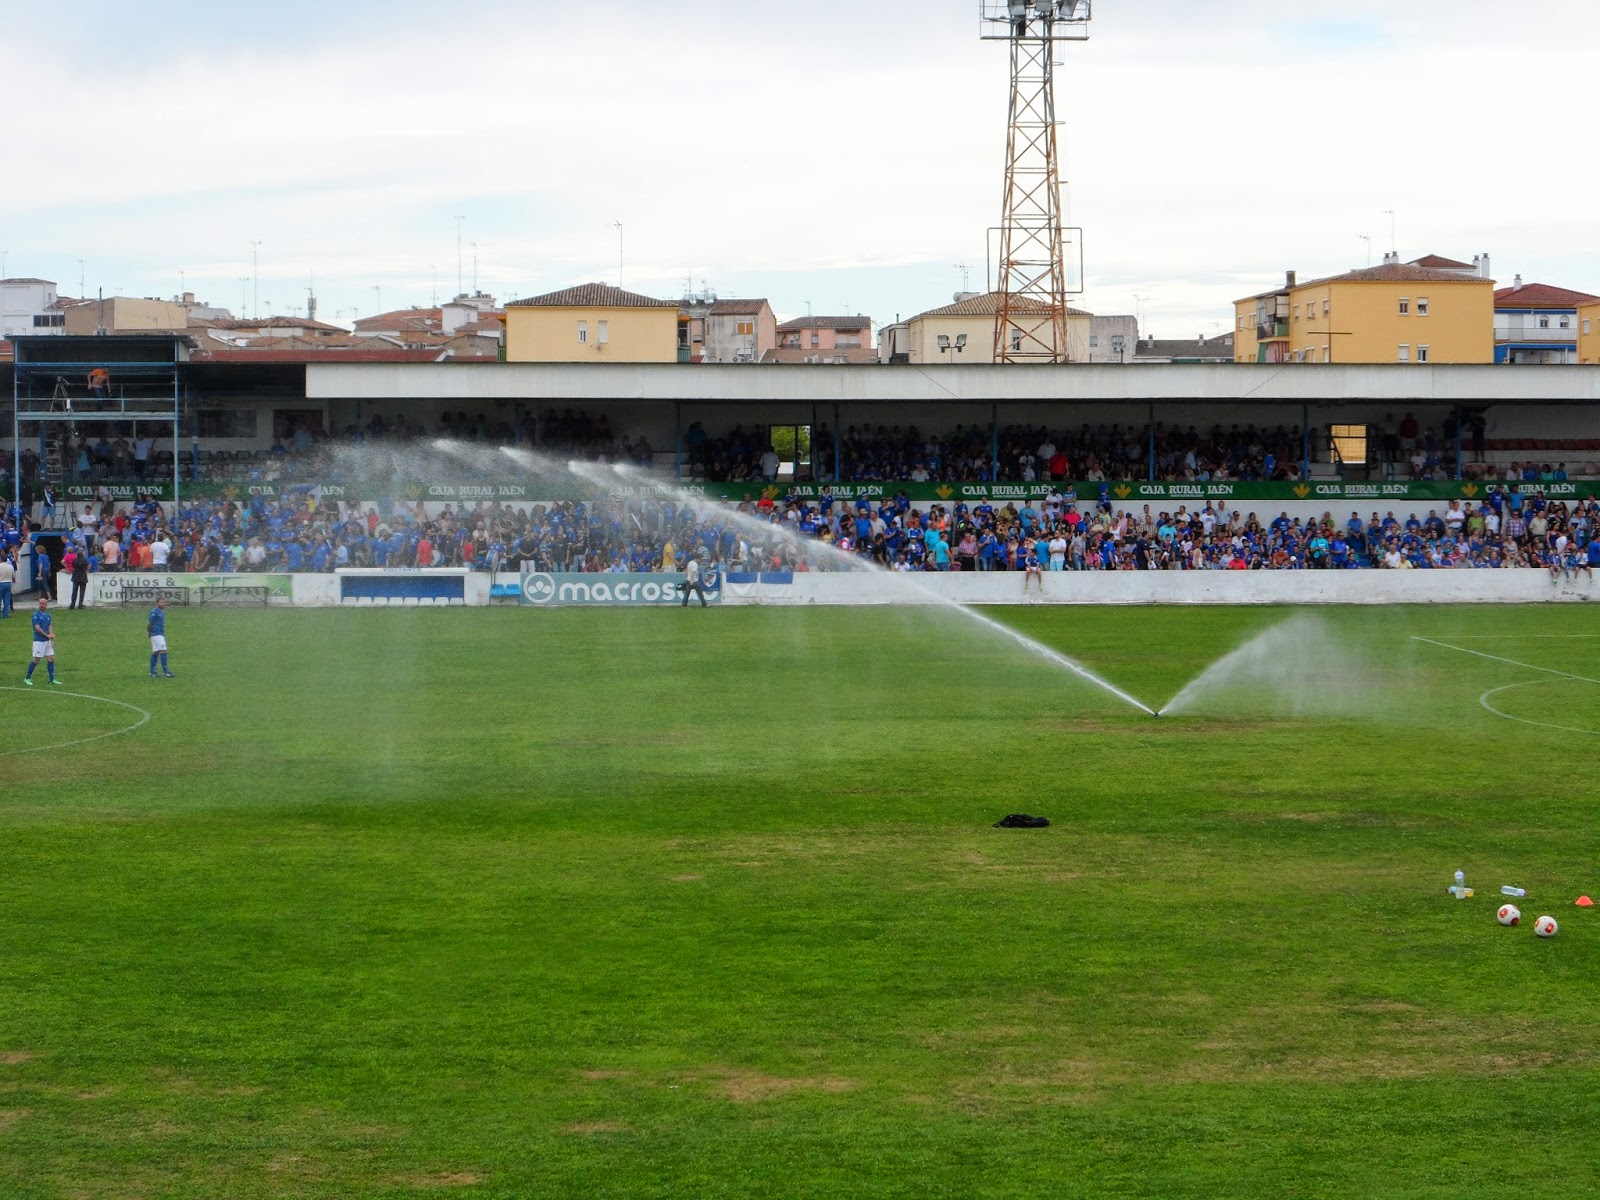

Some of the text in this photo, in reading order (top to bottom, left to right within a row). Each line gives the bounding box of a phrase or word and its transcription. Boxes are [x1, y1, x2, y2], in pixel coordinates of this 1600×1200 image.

[68, 486, 93, 495] CAJA
[248, 486, 274, 495] CJA
[320, 484, 345, 495] AÉN
[428, 484, 525, 496] CAJA RURAL JAÉN
[856, 483, 883, 496] JAÉN
[961, 485, 987, 495] CAJA
[991, 485, 1028, 495] RURAL
[1139, 483, 1234, 495] CAJA RURAL JAÉN
[1315, 483, 1408, 495] CAJA RURAL JAÉN
[1485, 482, 1576, 494] CA URAL JAÉN
[101, 575, 159, 587] rótulos
[165, 577, 176, 587] &
[99, 588, 182, 600] luminosos
